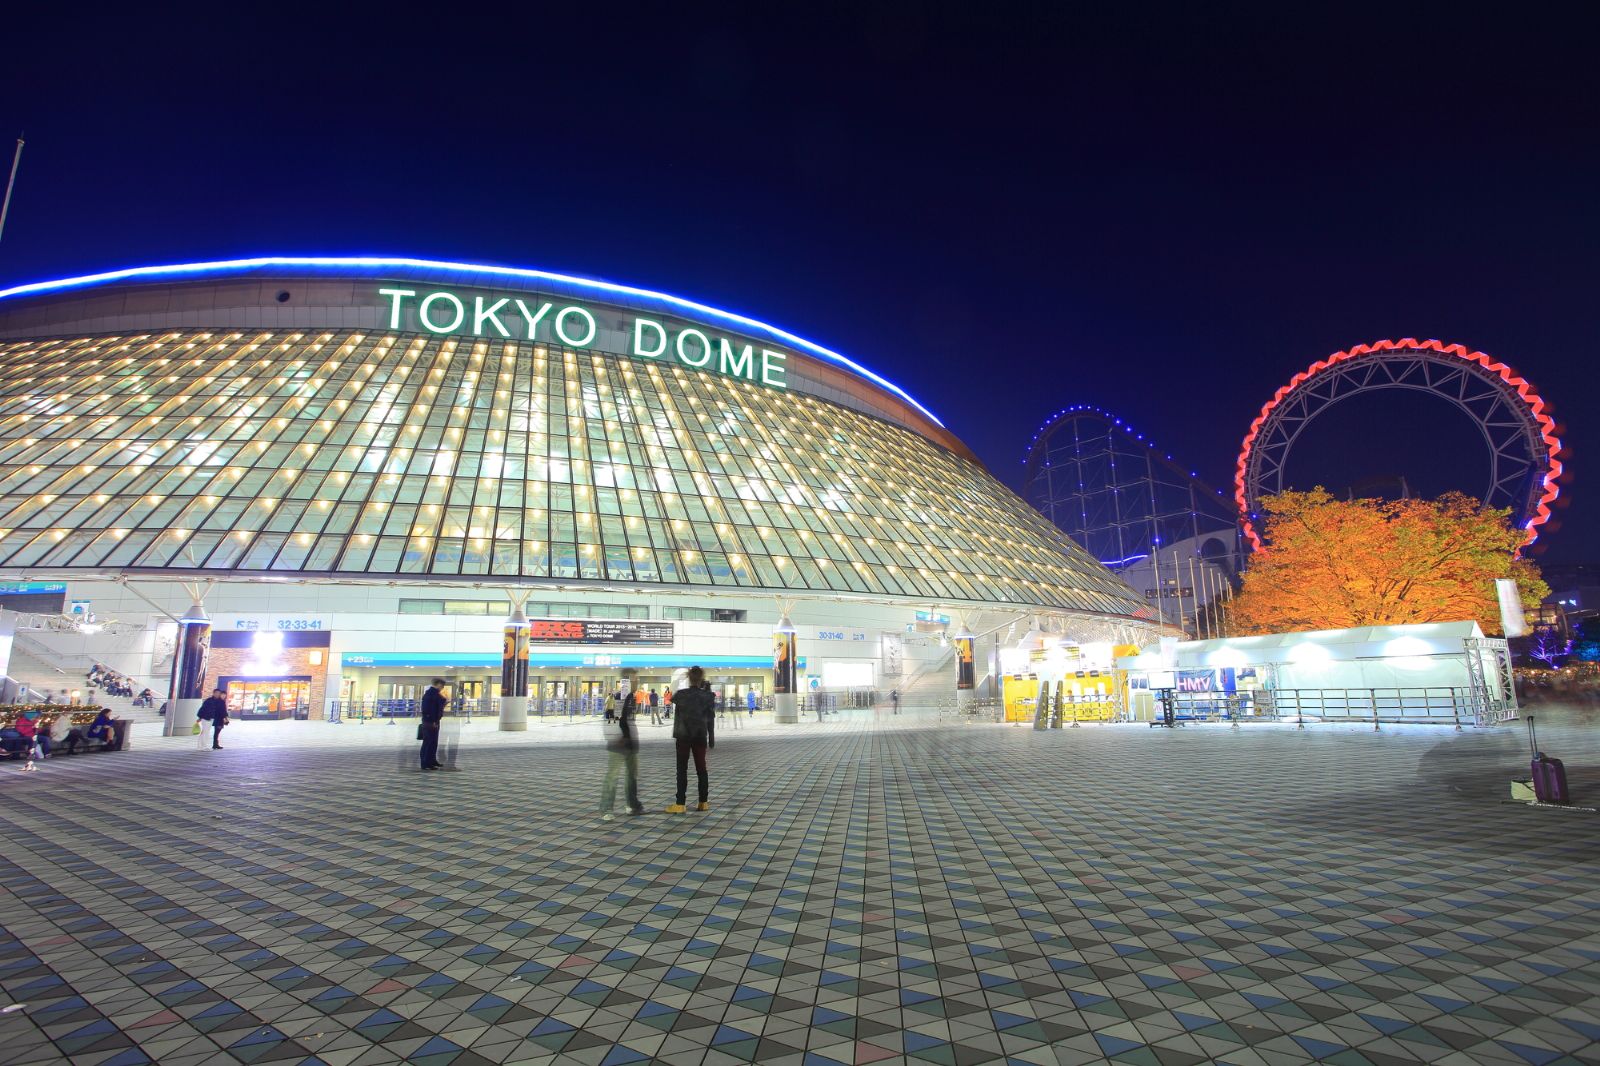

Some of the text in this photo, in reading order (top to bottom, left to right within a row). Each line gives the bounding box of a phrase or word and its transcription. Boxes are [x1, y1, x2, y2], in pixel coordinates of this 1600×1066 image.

[378, 289, 788, 389] TOKYO DOME
[1177, 677, 1211, 690] HMV
